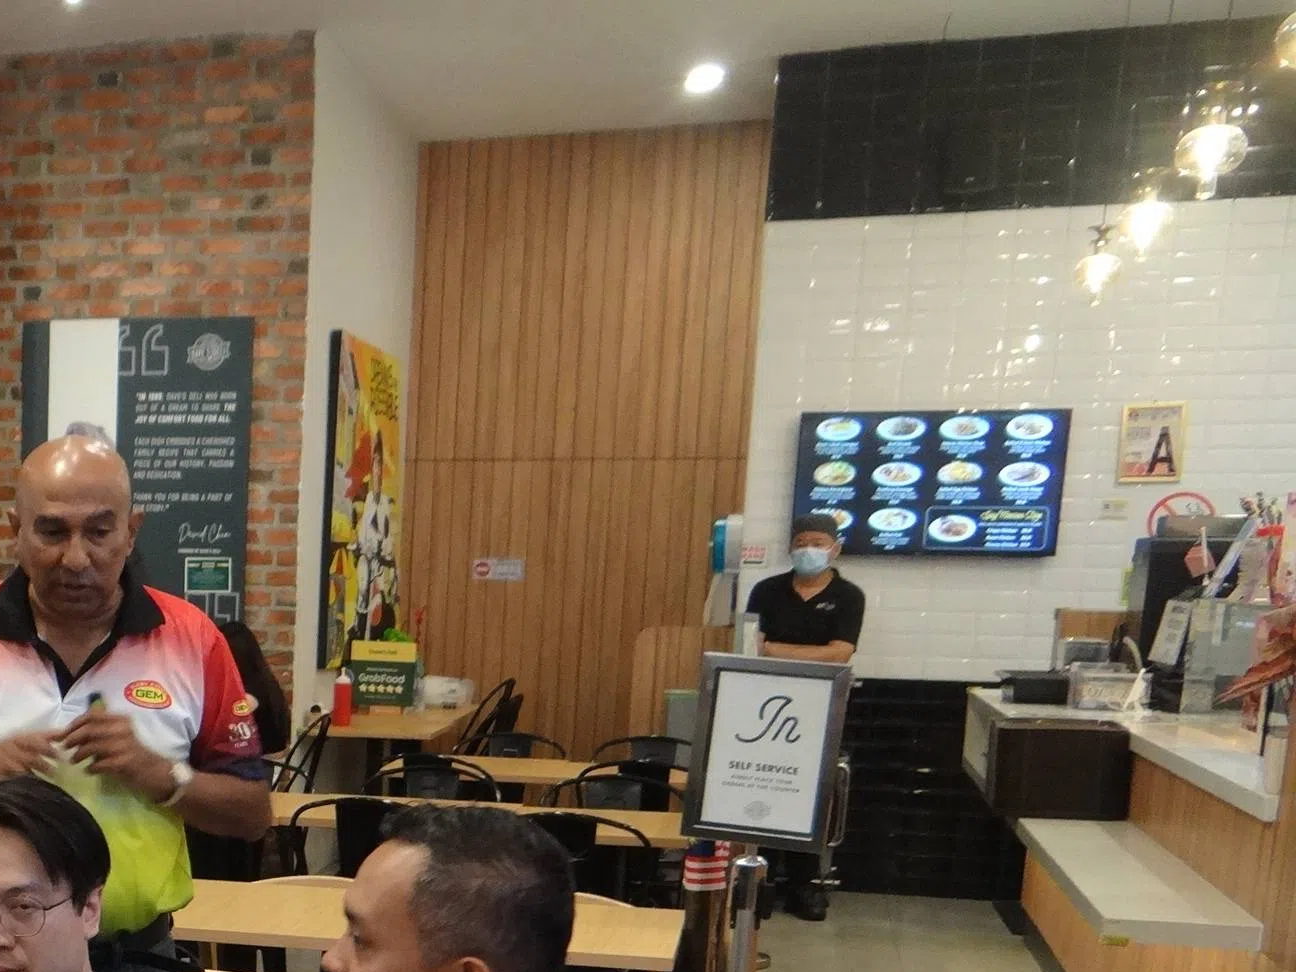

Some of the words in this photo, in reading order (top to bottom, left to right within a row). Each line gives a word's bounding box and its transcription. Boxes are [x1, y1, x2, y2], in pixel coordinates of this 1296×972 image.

[1146, 425, 1176, 474] A
[358, 672, 406, 684] GrabFood
[135, 689, 164, 701] GEM
[729, 760, 752, 770] SELF
[755, 763, 800, 776] SERVICE
